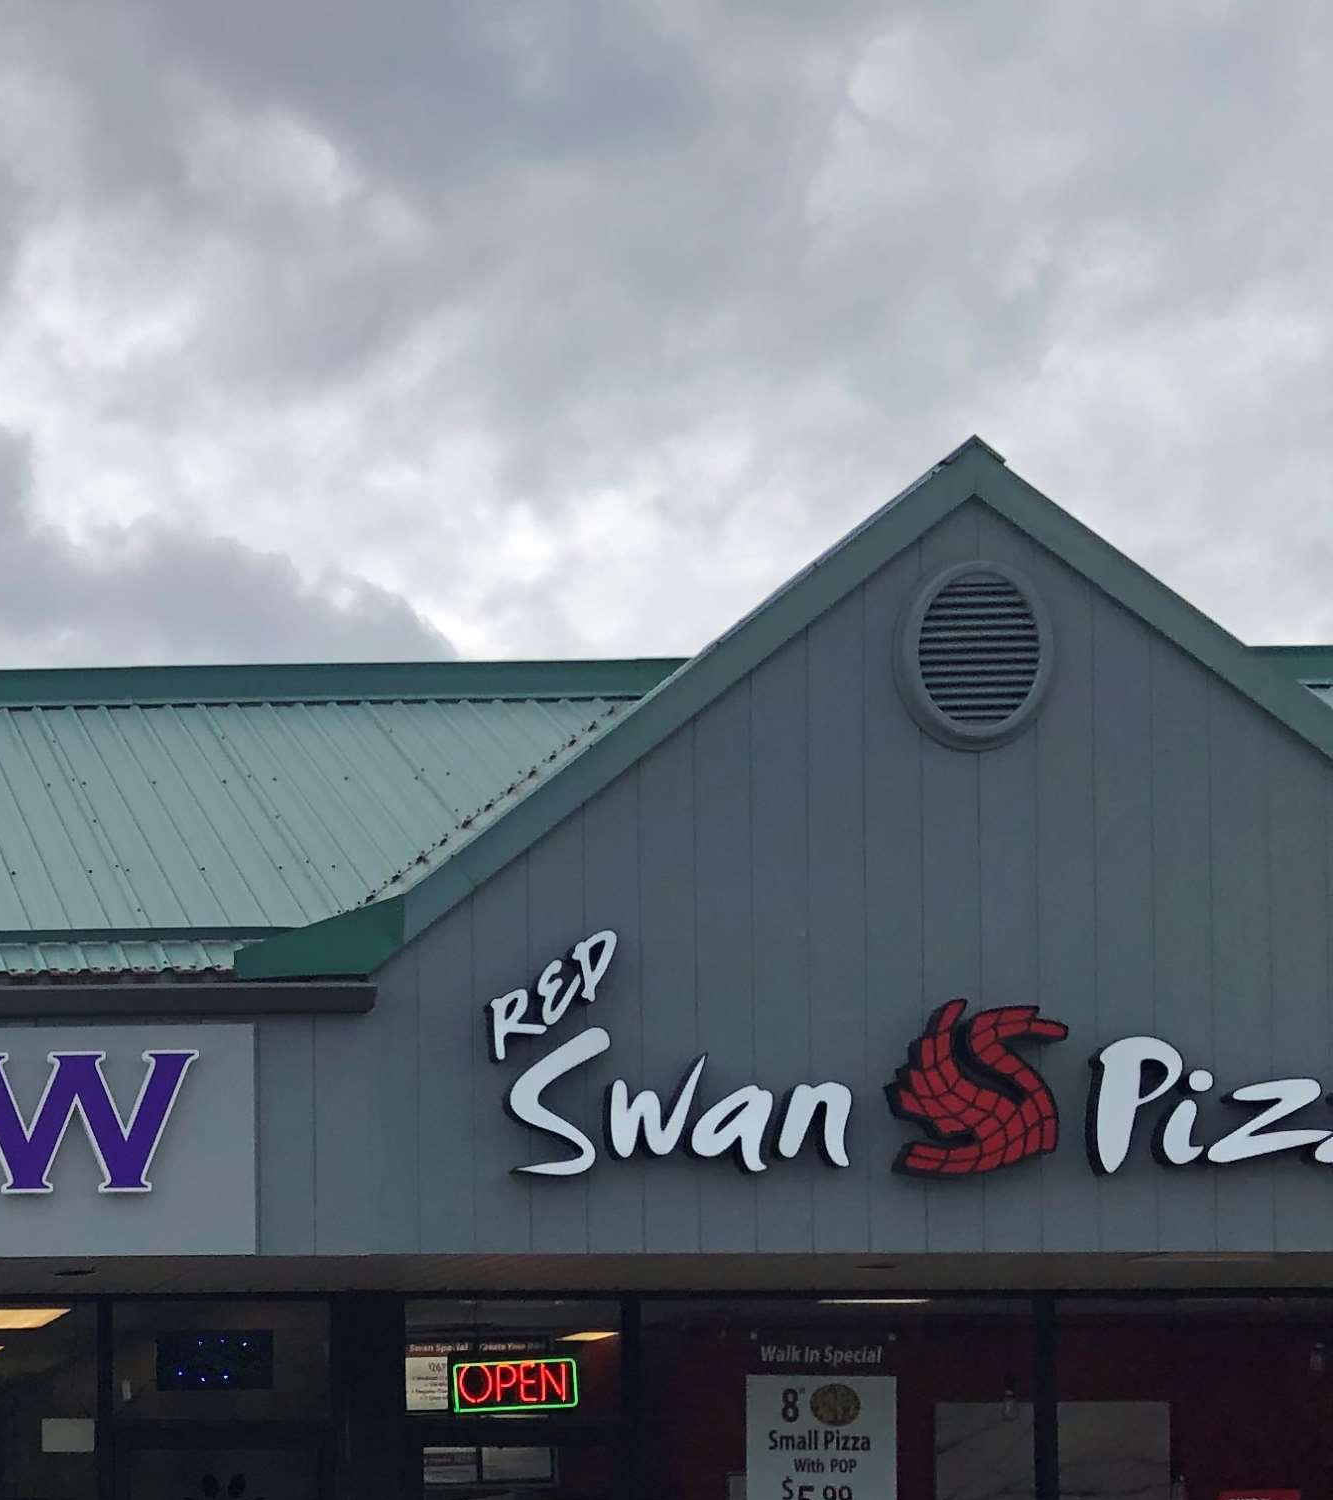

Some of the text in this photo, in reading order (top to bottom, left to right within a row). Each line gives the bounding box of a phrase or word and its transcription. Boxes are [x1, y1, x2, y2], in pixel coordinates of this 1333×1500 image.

[488, 930, 619, 1061] RED
[509, 1026, 1333, 1176] Swan Piz
[760, 1346, 883, 1365] Walk In Special
[459, 1360, 566, 1403] OPEN
[768, 1430, 872, 1452] Small Pizza
[793, 1458, 858, 1474] With POP
